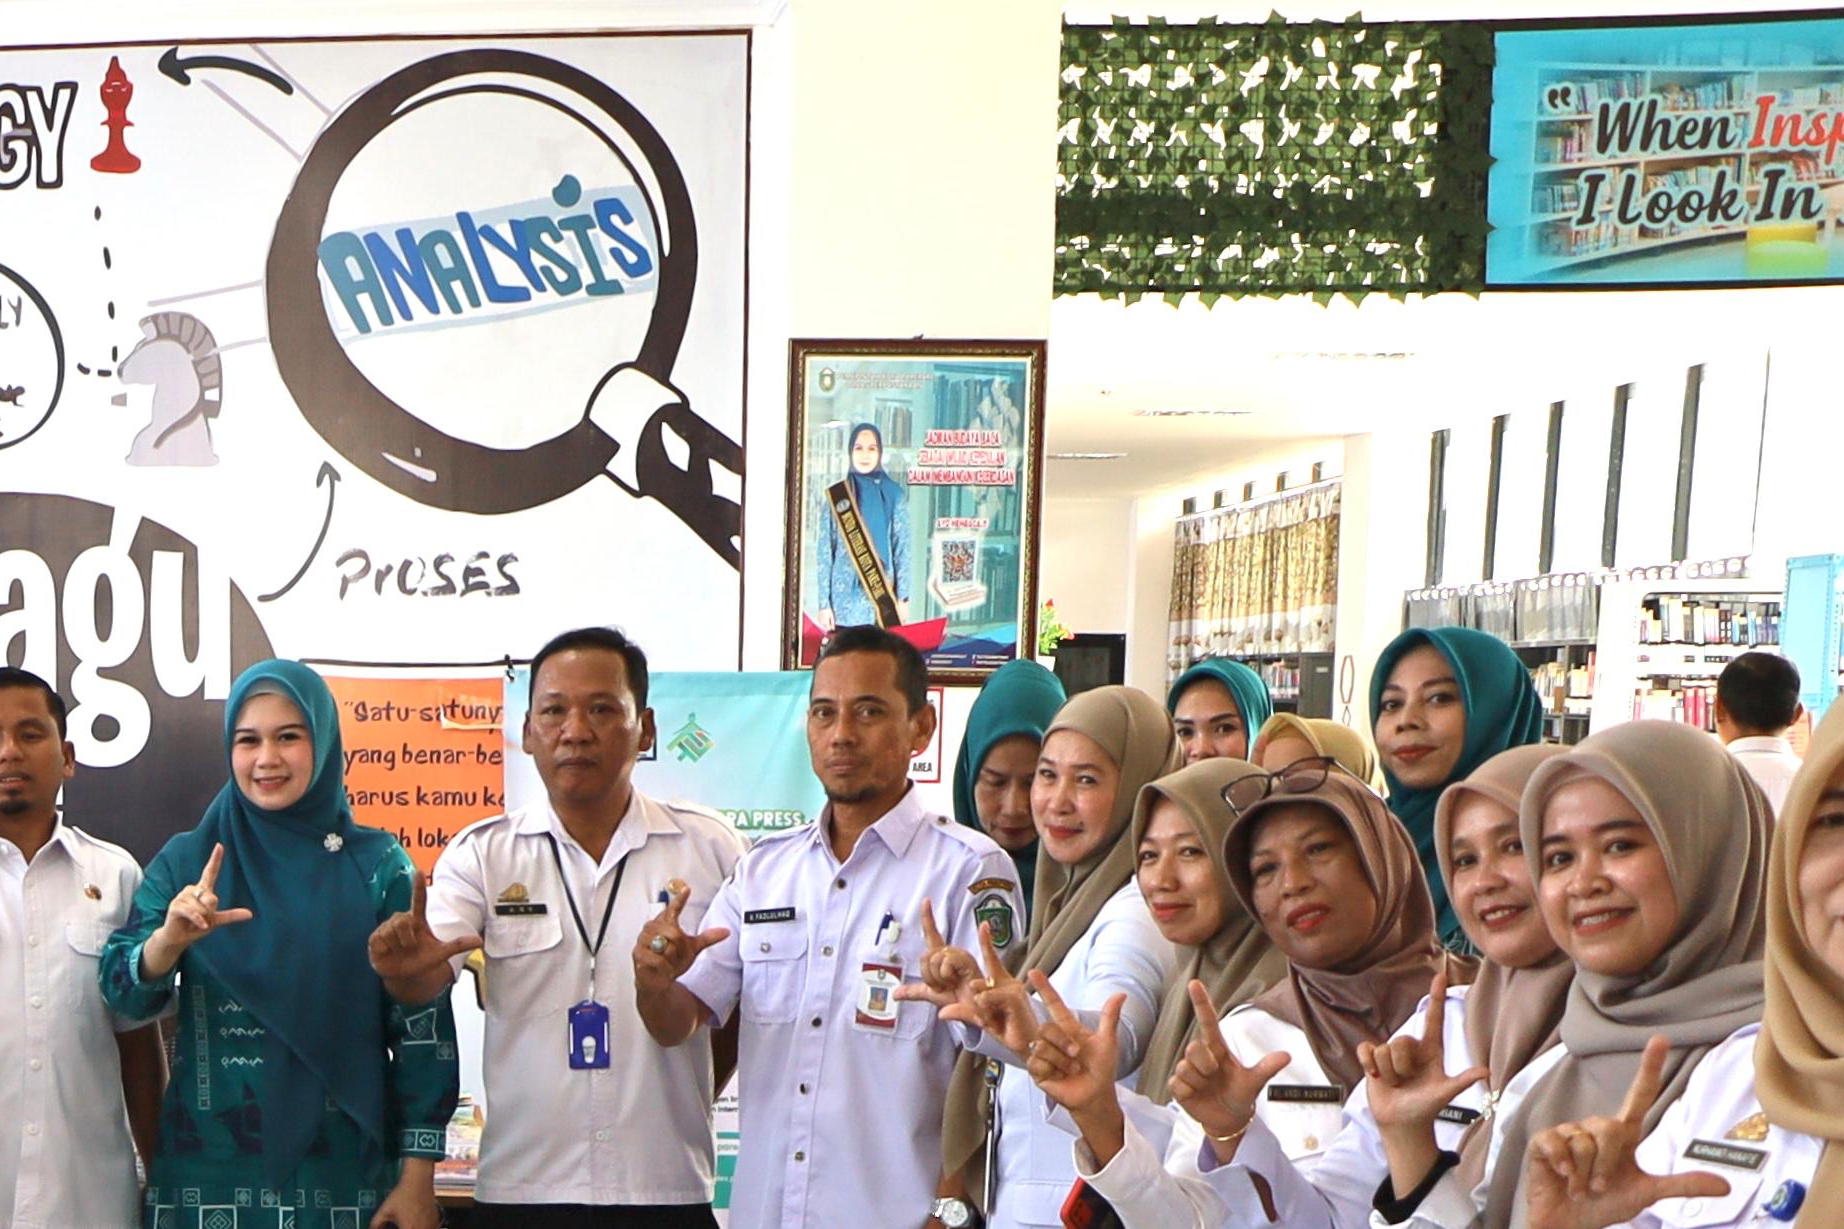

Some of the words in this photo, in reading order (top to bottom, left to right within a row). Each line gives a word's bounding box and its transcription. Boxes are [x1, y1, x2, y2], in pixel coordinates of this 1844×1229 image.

[1576, 174, 1606, 226] I
[1617, 169, 1745, 226] Look
[1754, 168, 1823, 222] In
[344, 747, 397, 777] yang
[402, 742, 503, 766] benar-be
[912, 761, 933, 773] AREA
[416, 786, 477, 806] kamu
[753, 811, 803, 828] PRESS
